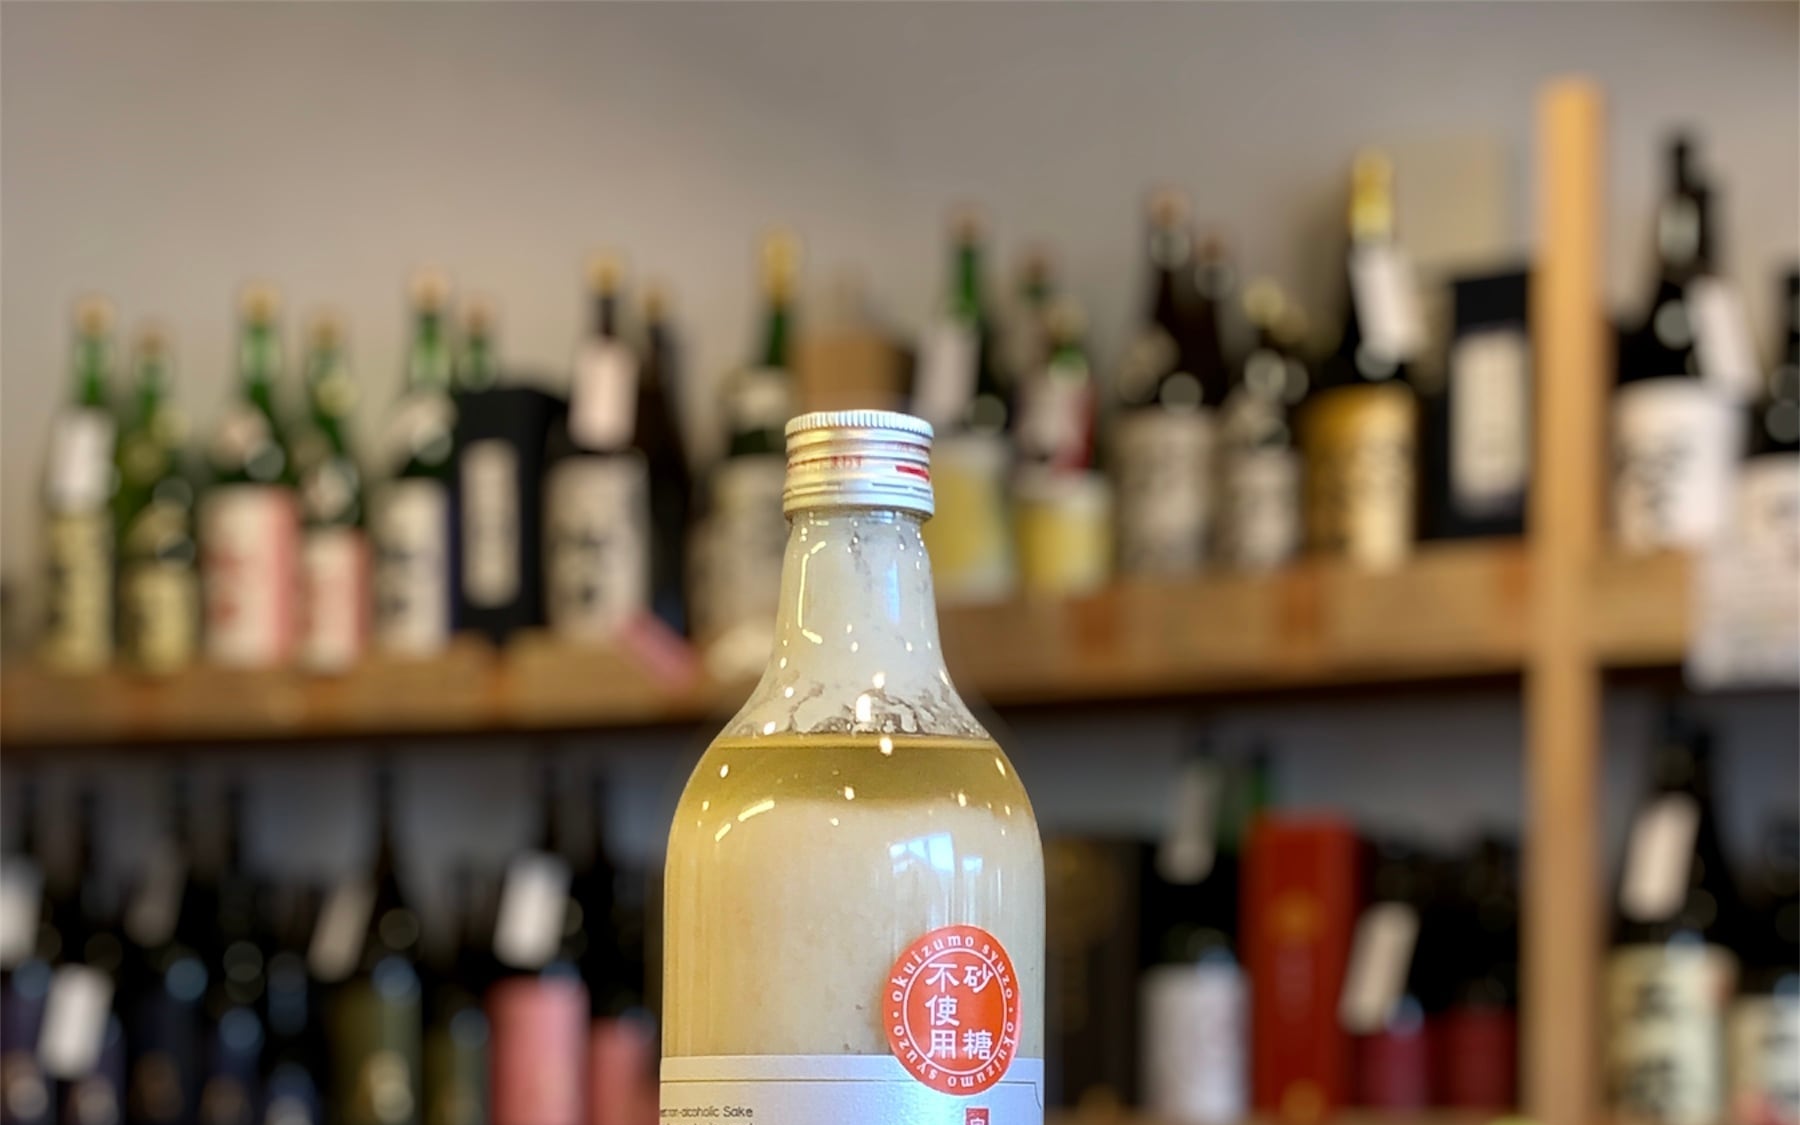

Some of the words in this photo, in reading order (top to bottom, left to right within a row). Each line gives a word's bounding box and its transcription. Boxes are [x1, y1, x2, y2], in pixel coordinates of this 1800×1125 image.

[891, 934, 975, 1002] okuizumo
[982, 944, 1013, 999] syuzo
[925, 962, 960, 1060] 不使用
[963, 963, 994, 1060] 砂糖
[892, 1024, 939, 1080] syuzo
[947, 1021, 1016, 1088] okuizumo
[722, 1105, 753, 1118] Sake
